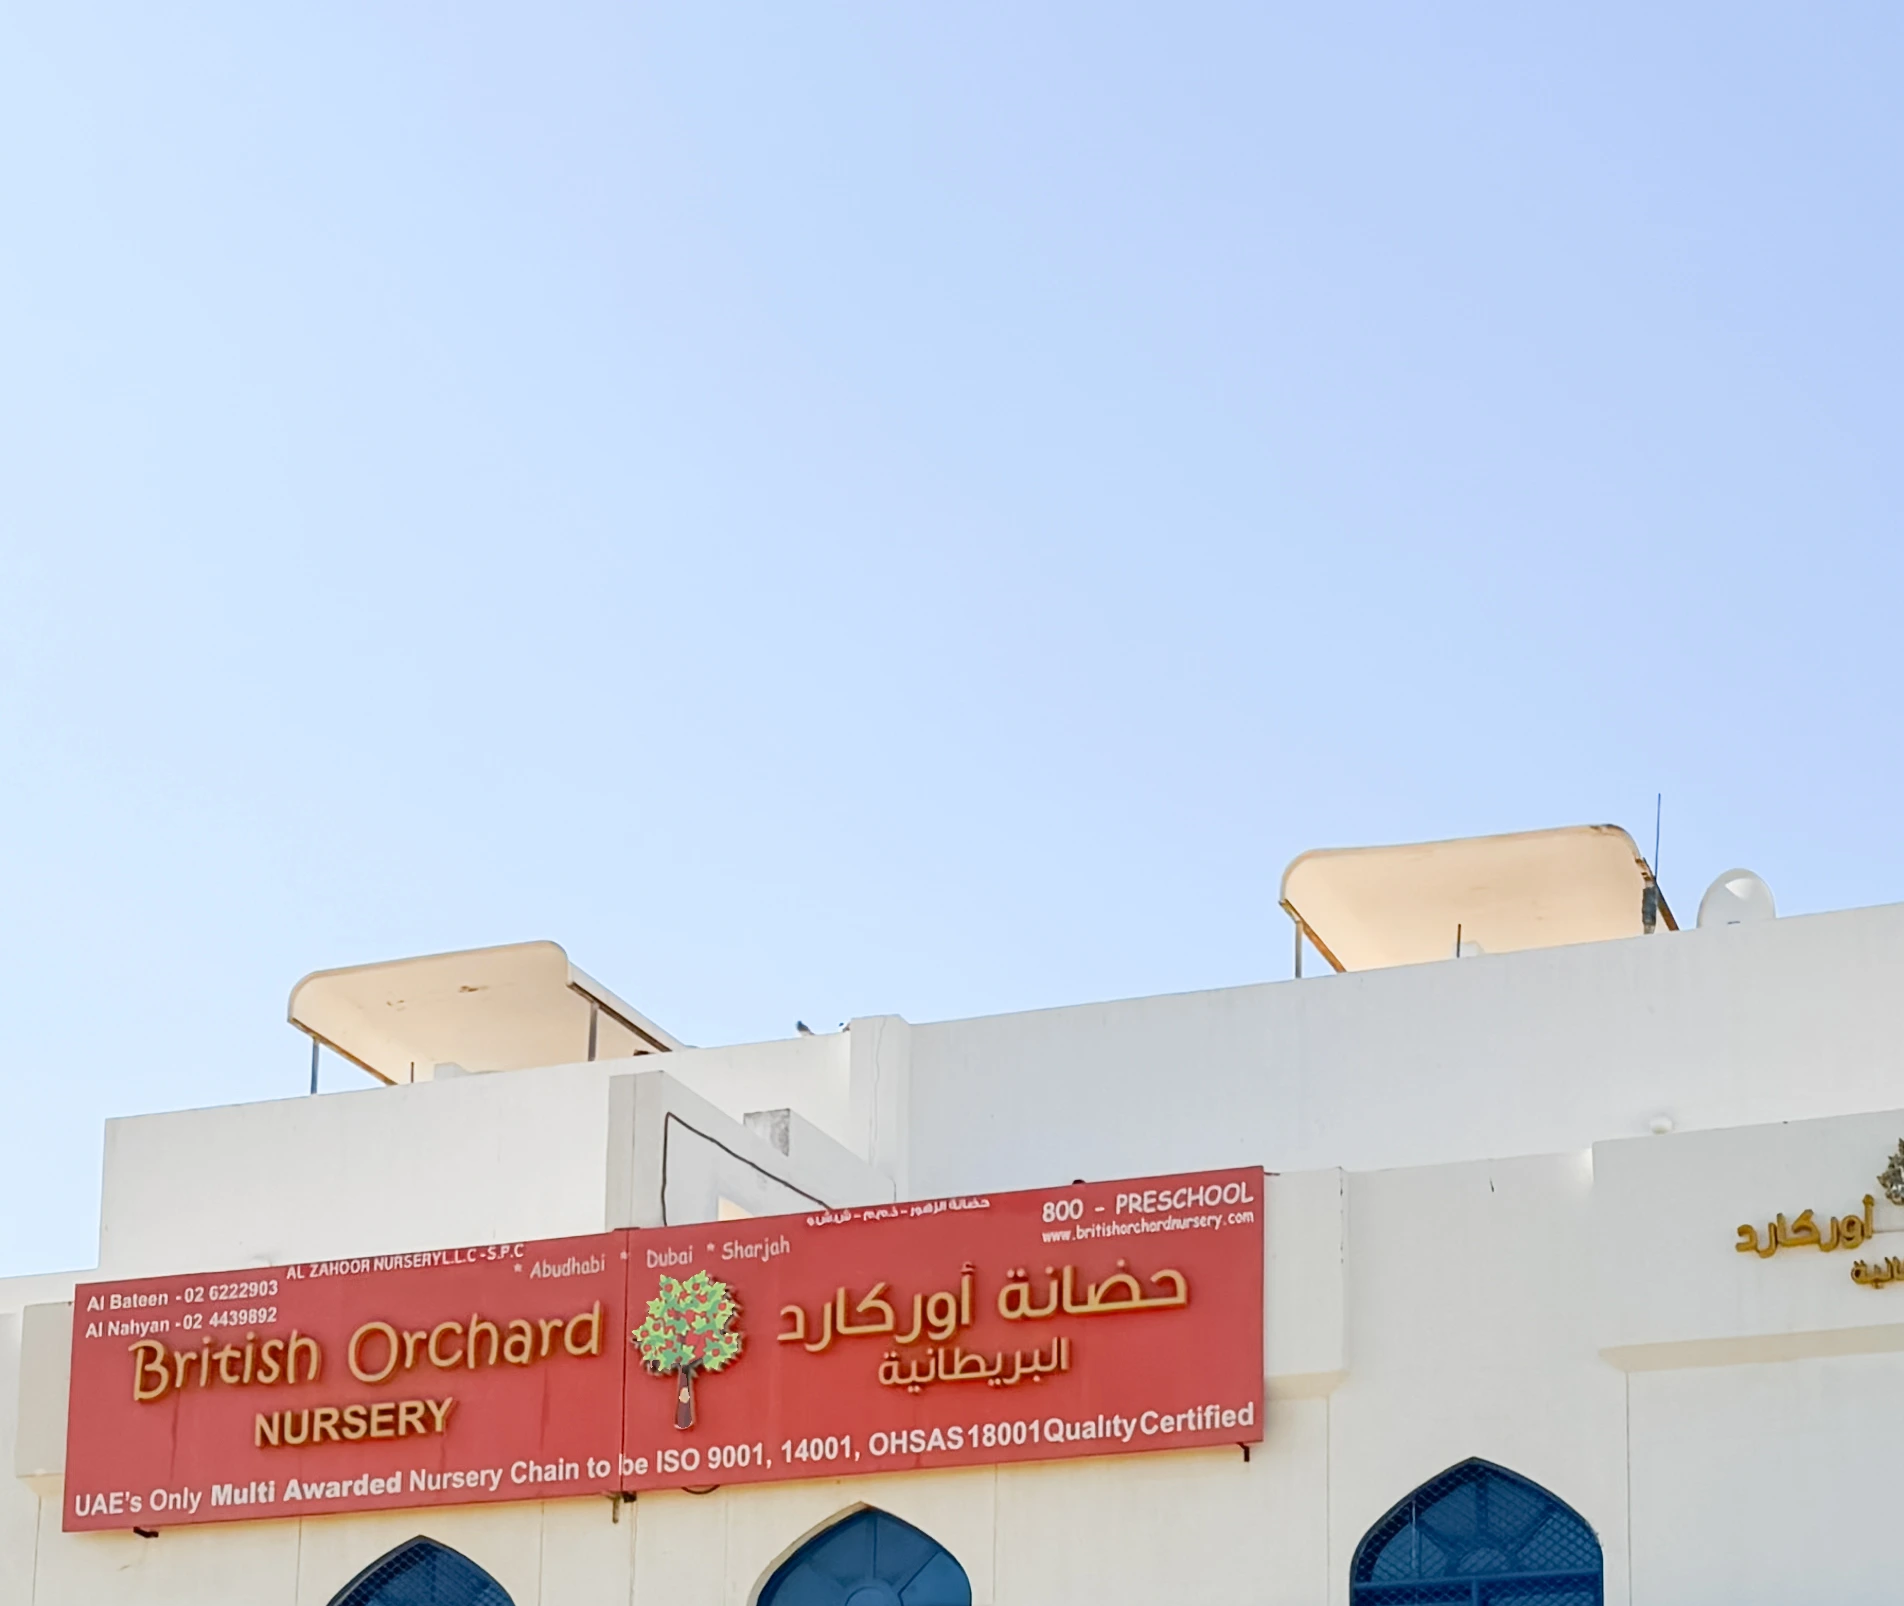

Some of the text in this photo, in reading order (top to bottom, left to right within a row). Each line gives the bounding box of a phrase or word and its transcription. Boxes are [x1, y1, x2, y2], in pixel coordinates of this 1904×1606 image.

[1042, 1199, 1084, 1223] 800
[1116, 1182, 1254, 1215] PRESCHOOL
[1735, 1194, 1875, 1258] أوركارد
[1042, 1211, 1254, 1243] www.britishorchardnursery.com
[286, 1265, 304, 1280] AL
[309, 1258, 370, 1279] ZAHOOR
[529, 1234, 790, 1279] Abudhabi Dubai Sharjah
[86, 1295, 105, 1312] Al
[109, 1292, 169, 1310] Bateen
[209, 1280, 278, 1301] 6222903
[777, 1259, 1188, 1352] حضانة أوركارد
[85, 1322, 103, 1338] Al
[107, 1318, 170, 1338] Nahyan
[209, 1307, 278, 1328] 4439892
[128, 1301, 602, 1402] British Orchard
[878, 1337, 1071, 1394] البريطانية
[254, 1397, 454, 1447] NURSERY
[74, 1491, 143, 1517] UAE's
[149, 1487, 202, 1514] Only
[211, 1480, 276, 1507] Multi
[283, 1471, 402, 1502] Awarded
[409, 1466, 503, 1493] Nursery
[510, 1458, 579, 1485] Chain
[586, 1457, 611, 1479] to
[619, 1453, 649, 1476] be
[656, 1448, 700, 1473] ISO
[707, 1443, 773, 1470] 9001,
[781, 1434, 861, 1464] 14001,
[1140, 1401, 1255, 1435] Certified
